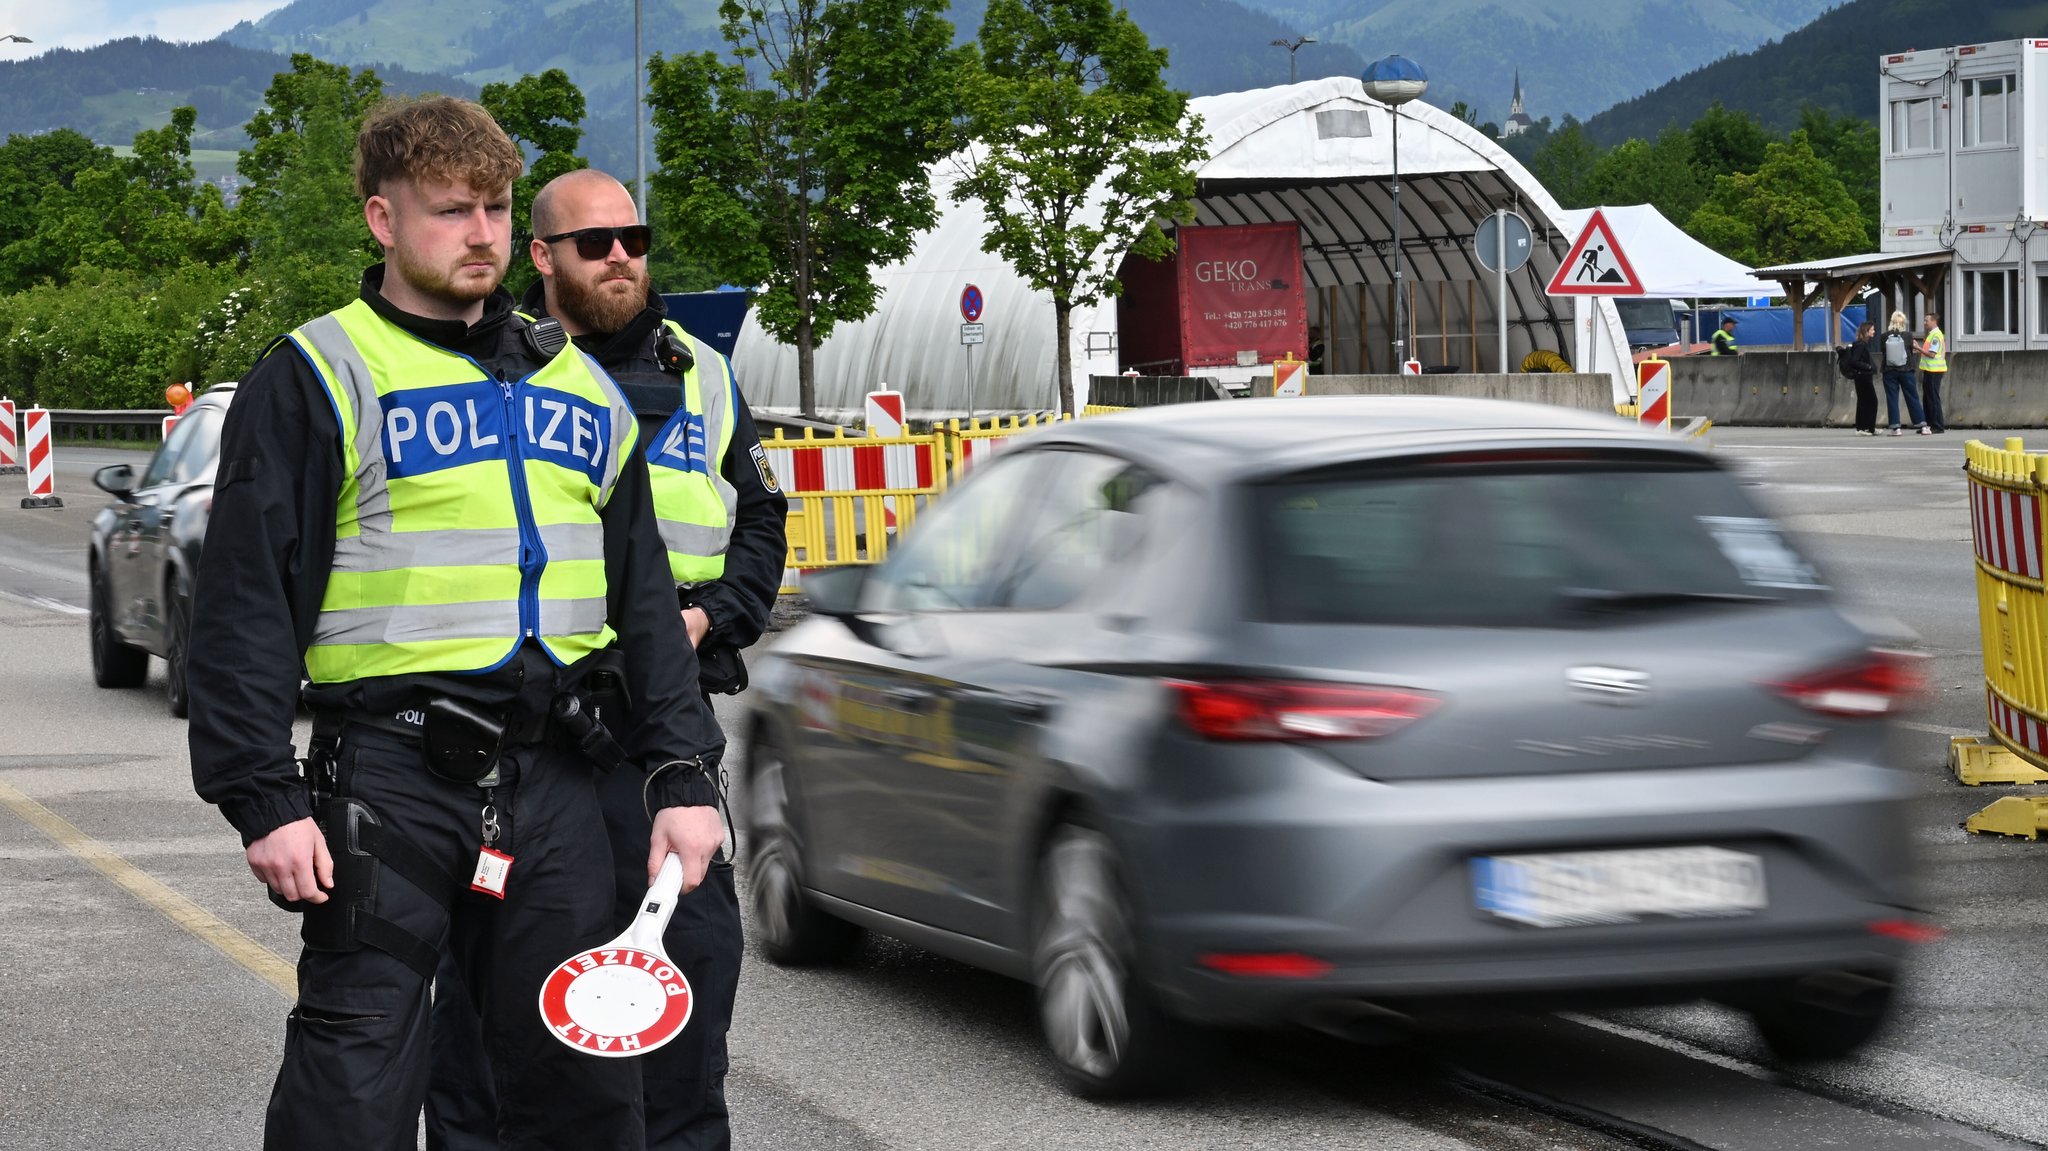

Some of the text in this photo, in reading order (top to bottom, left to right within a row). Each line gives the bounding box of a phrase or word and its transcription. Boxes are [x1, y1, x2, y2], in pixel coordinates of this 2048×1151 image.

[1195, 260, 1257, 282] GEKO
[1229, 279, 1272, 292] TRANS
[1223, 311, 1242, 319] +420
[1243, 310, 1257, 319] 720
[1258, 309, 1272, 318] 328
[1273, 308, 1287, 317] 384
[1224, 318, 1288, 329] +420 776 417 676
[386, 396, 603, 468] POLIZEI
[562, 950, 687, 997] POLIZEI
[555, 1022, 641, 1051] HALT
